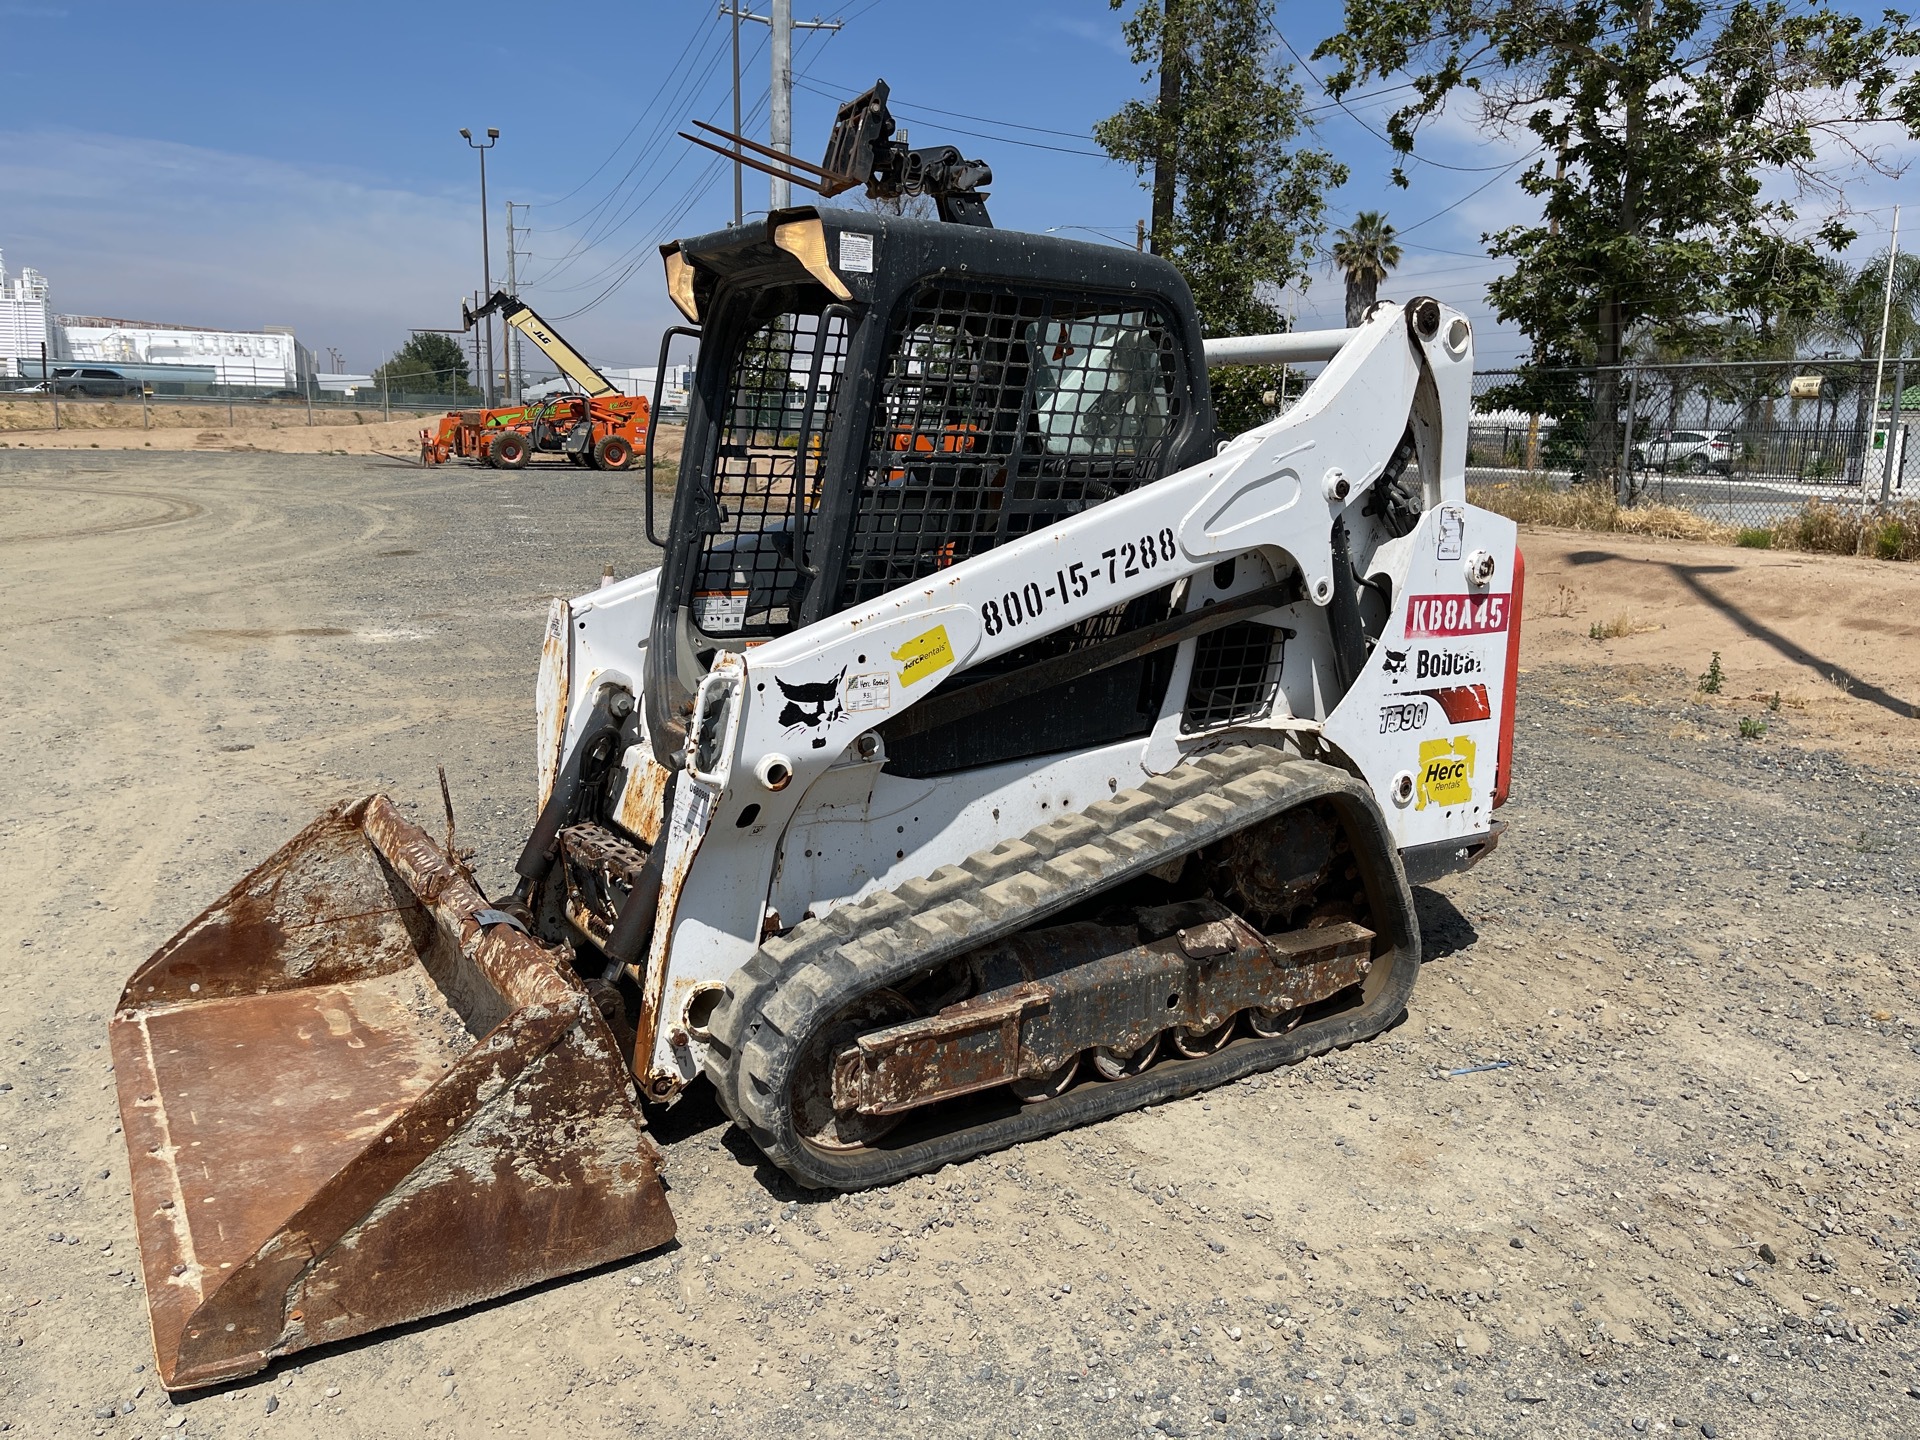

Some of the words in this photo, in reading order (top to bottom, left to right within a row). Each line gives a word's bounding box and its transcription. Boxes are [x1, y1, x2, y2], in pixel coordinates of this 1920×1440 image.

[533, 331, 551, 344] JLG
[519, 405, 557, 422] XTRME
[981, 528, 1176, 636] 800-15-7288
[1412, 598, 1503, 631] KB8A45
[1416, 648, 1482, 679] Bobca
[1379, 702, 1428, 734] T590
[1425, 763, 1465, 783] Herc
[1434, 780, 1461, 791] Rentals
